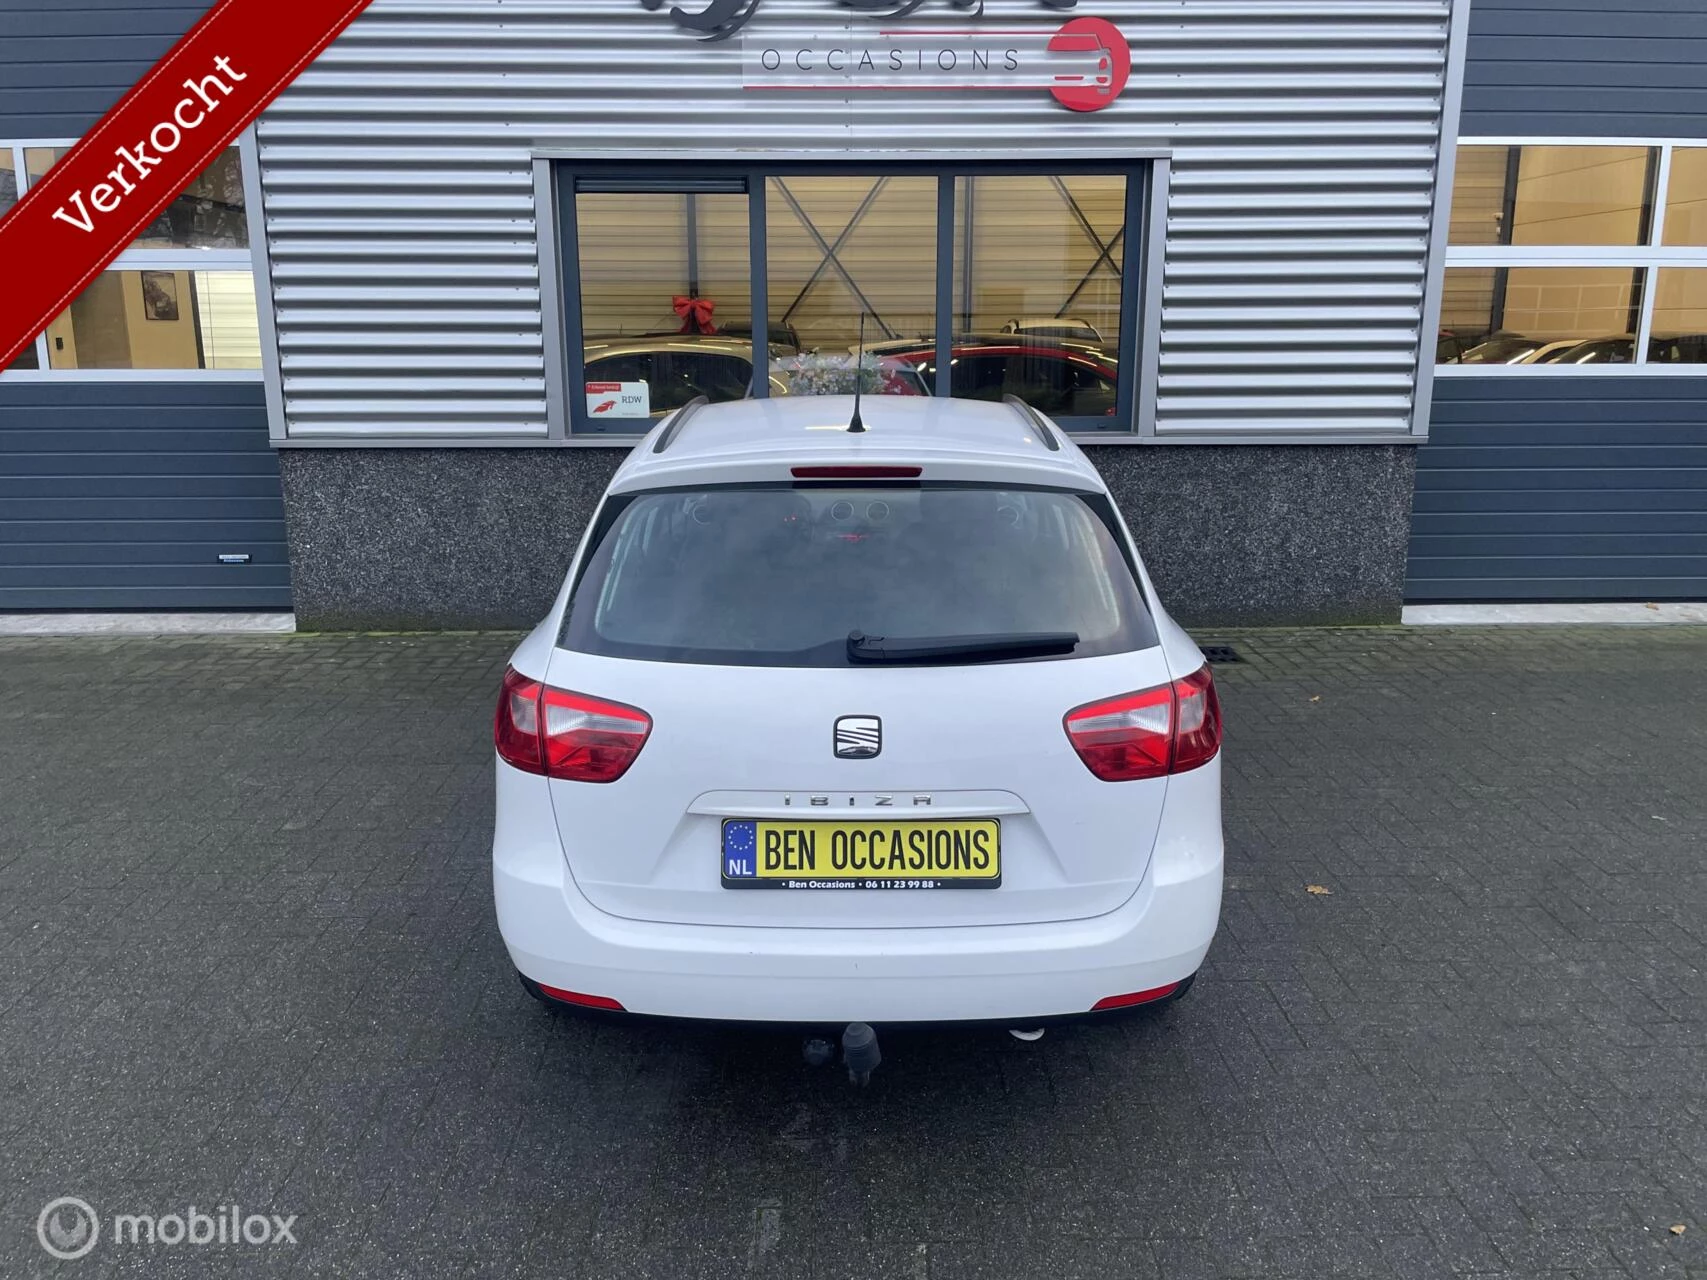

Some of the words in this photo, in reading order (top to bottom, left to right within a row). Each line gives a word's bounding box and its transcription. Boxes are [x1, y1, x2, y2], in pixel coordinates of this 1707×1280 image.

[761, 48, 1018, 71] OCCASIONS
[621, 395, 642, 404] RDW
[785, 794, 931, 806] IBIZA
[765, 830, 815, 870] BEN
[832, 830, 990, 870] OCCASIONS
[729, 859, 752, 875] NL
[788, 880, 807, 889] Ben
[809, 880, 856, 889] Occasions
[865, 880, 878, 889] 06
[880, 880, 891, 889] 11
[893, 880, 906, 889] 23
[907, 880, 920, 889] 99
[921, 880, 934, 889] 88
